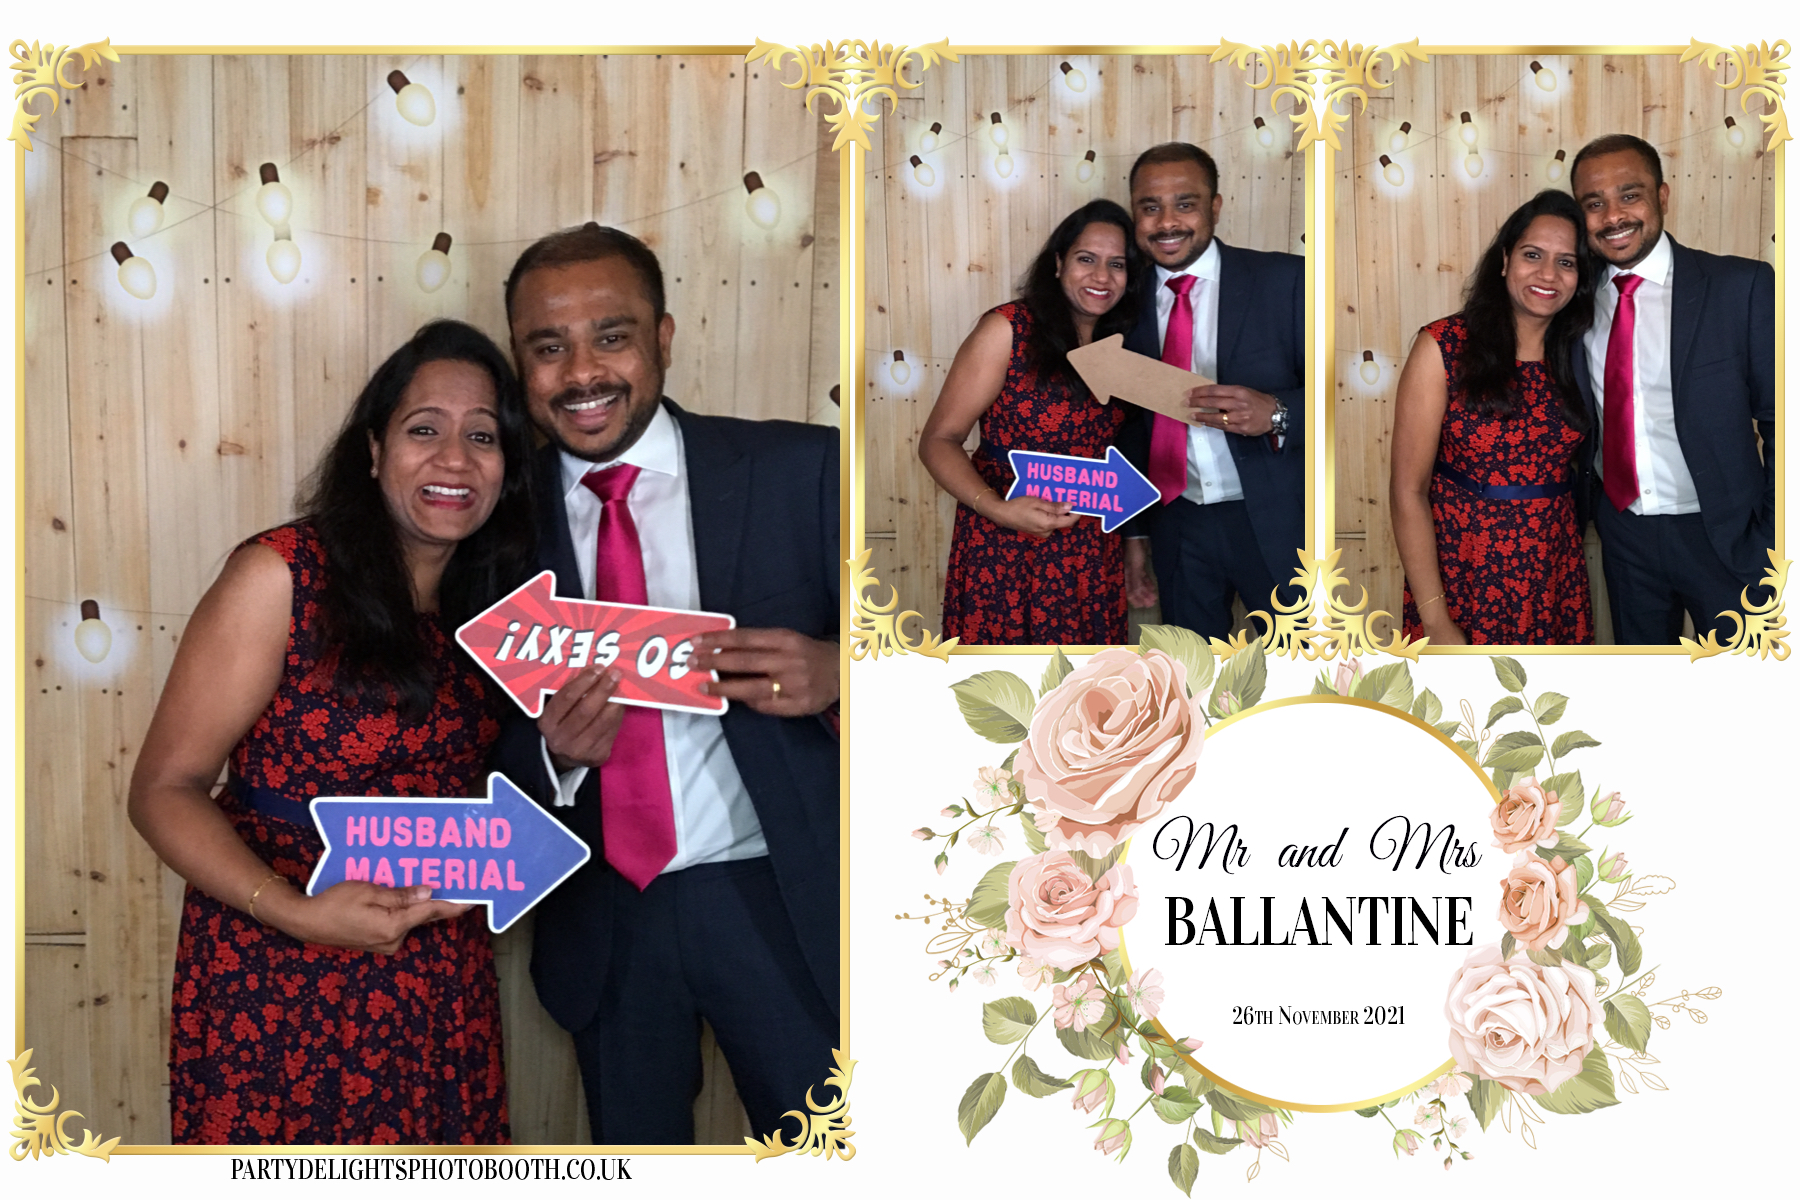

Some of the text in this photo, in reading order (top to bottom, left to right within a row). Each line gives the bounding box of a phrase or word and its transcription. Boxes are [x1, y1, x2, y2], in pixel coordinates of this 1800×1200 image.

[1027, 462, 1118, 488] HUSBAND
[1026, 484, 1124, 512] MATERIAL
[495, 620, 694, 679] SO SEXY!
[346, 816, 512, 848] HUSBAND
[345, 857, 525, 891] MATERIAL
